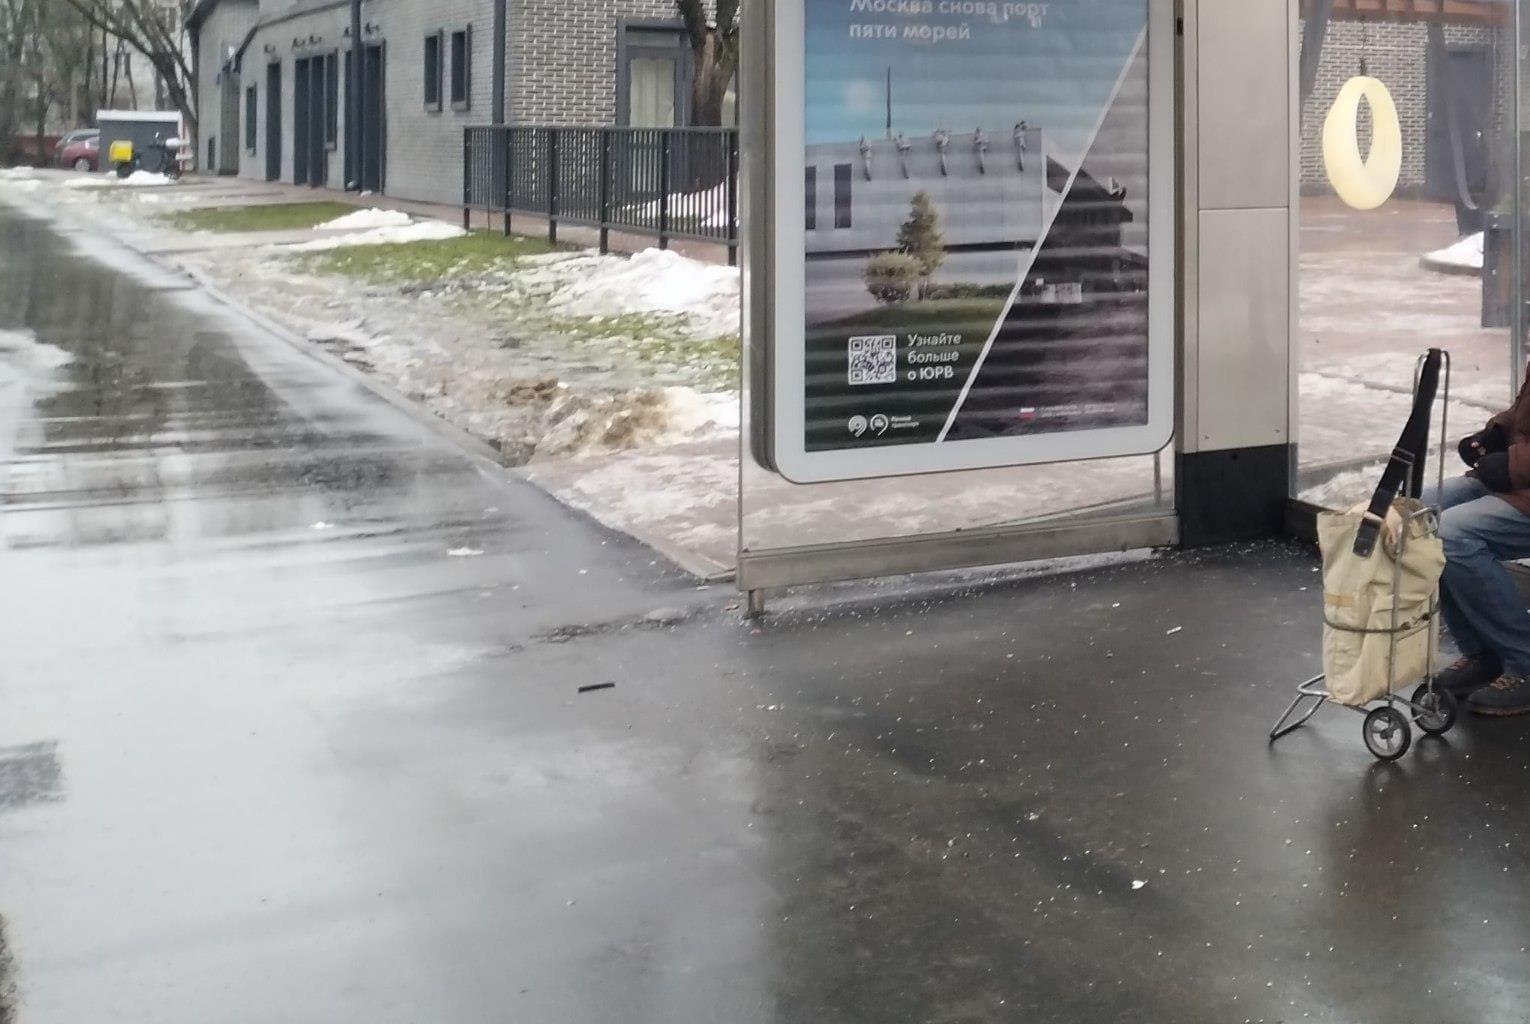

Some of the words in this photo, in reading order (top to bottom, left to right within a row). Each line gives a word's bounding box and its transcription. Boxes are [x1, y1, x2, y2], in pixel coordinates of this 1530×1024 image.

[938, 0, 997, 17] снова
[1003, 1, 1050, 21] порт
[848, 22, 897, 39] пяти
[902, 22, 971, 43] морей
[907, 332, 962, 347] Узнайте
[907, 350, 960, 365] больше
[907, 370, 917, 381] о
[920, 365, 955, 380] ЮРВ
